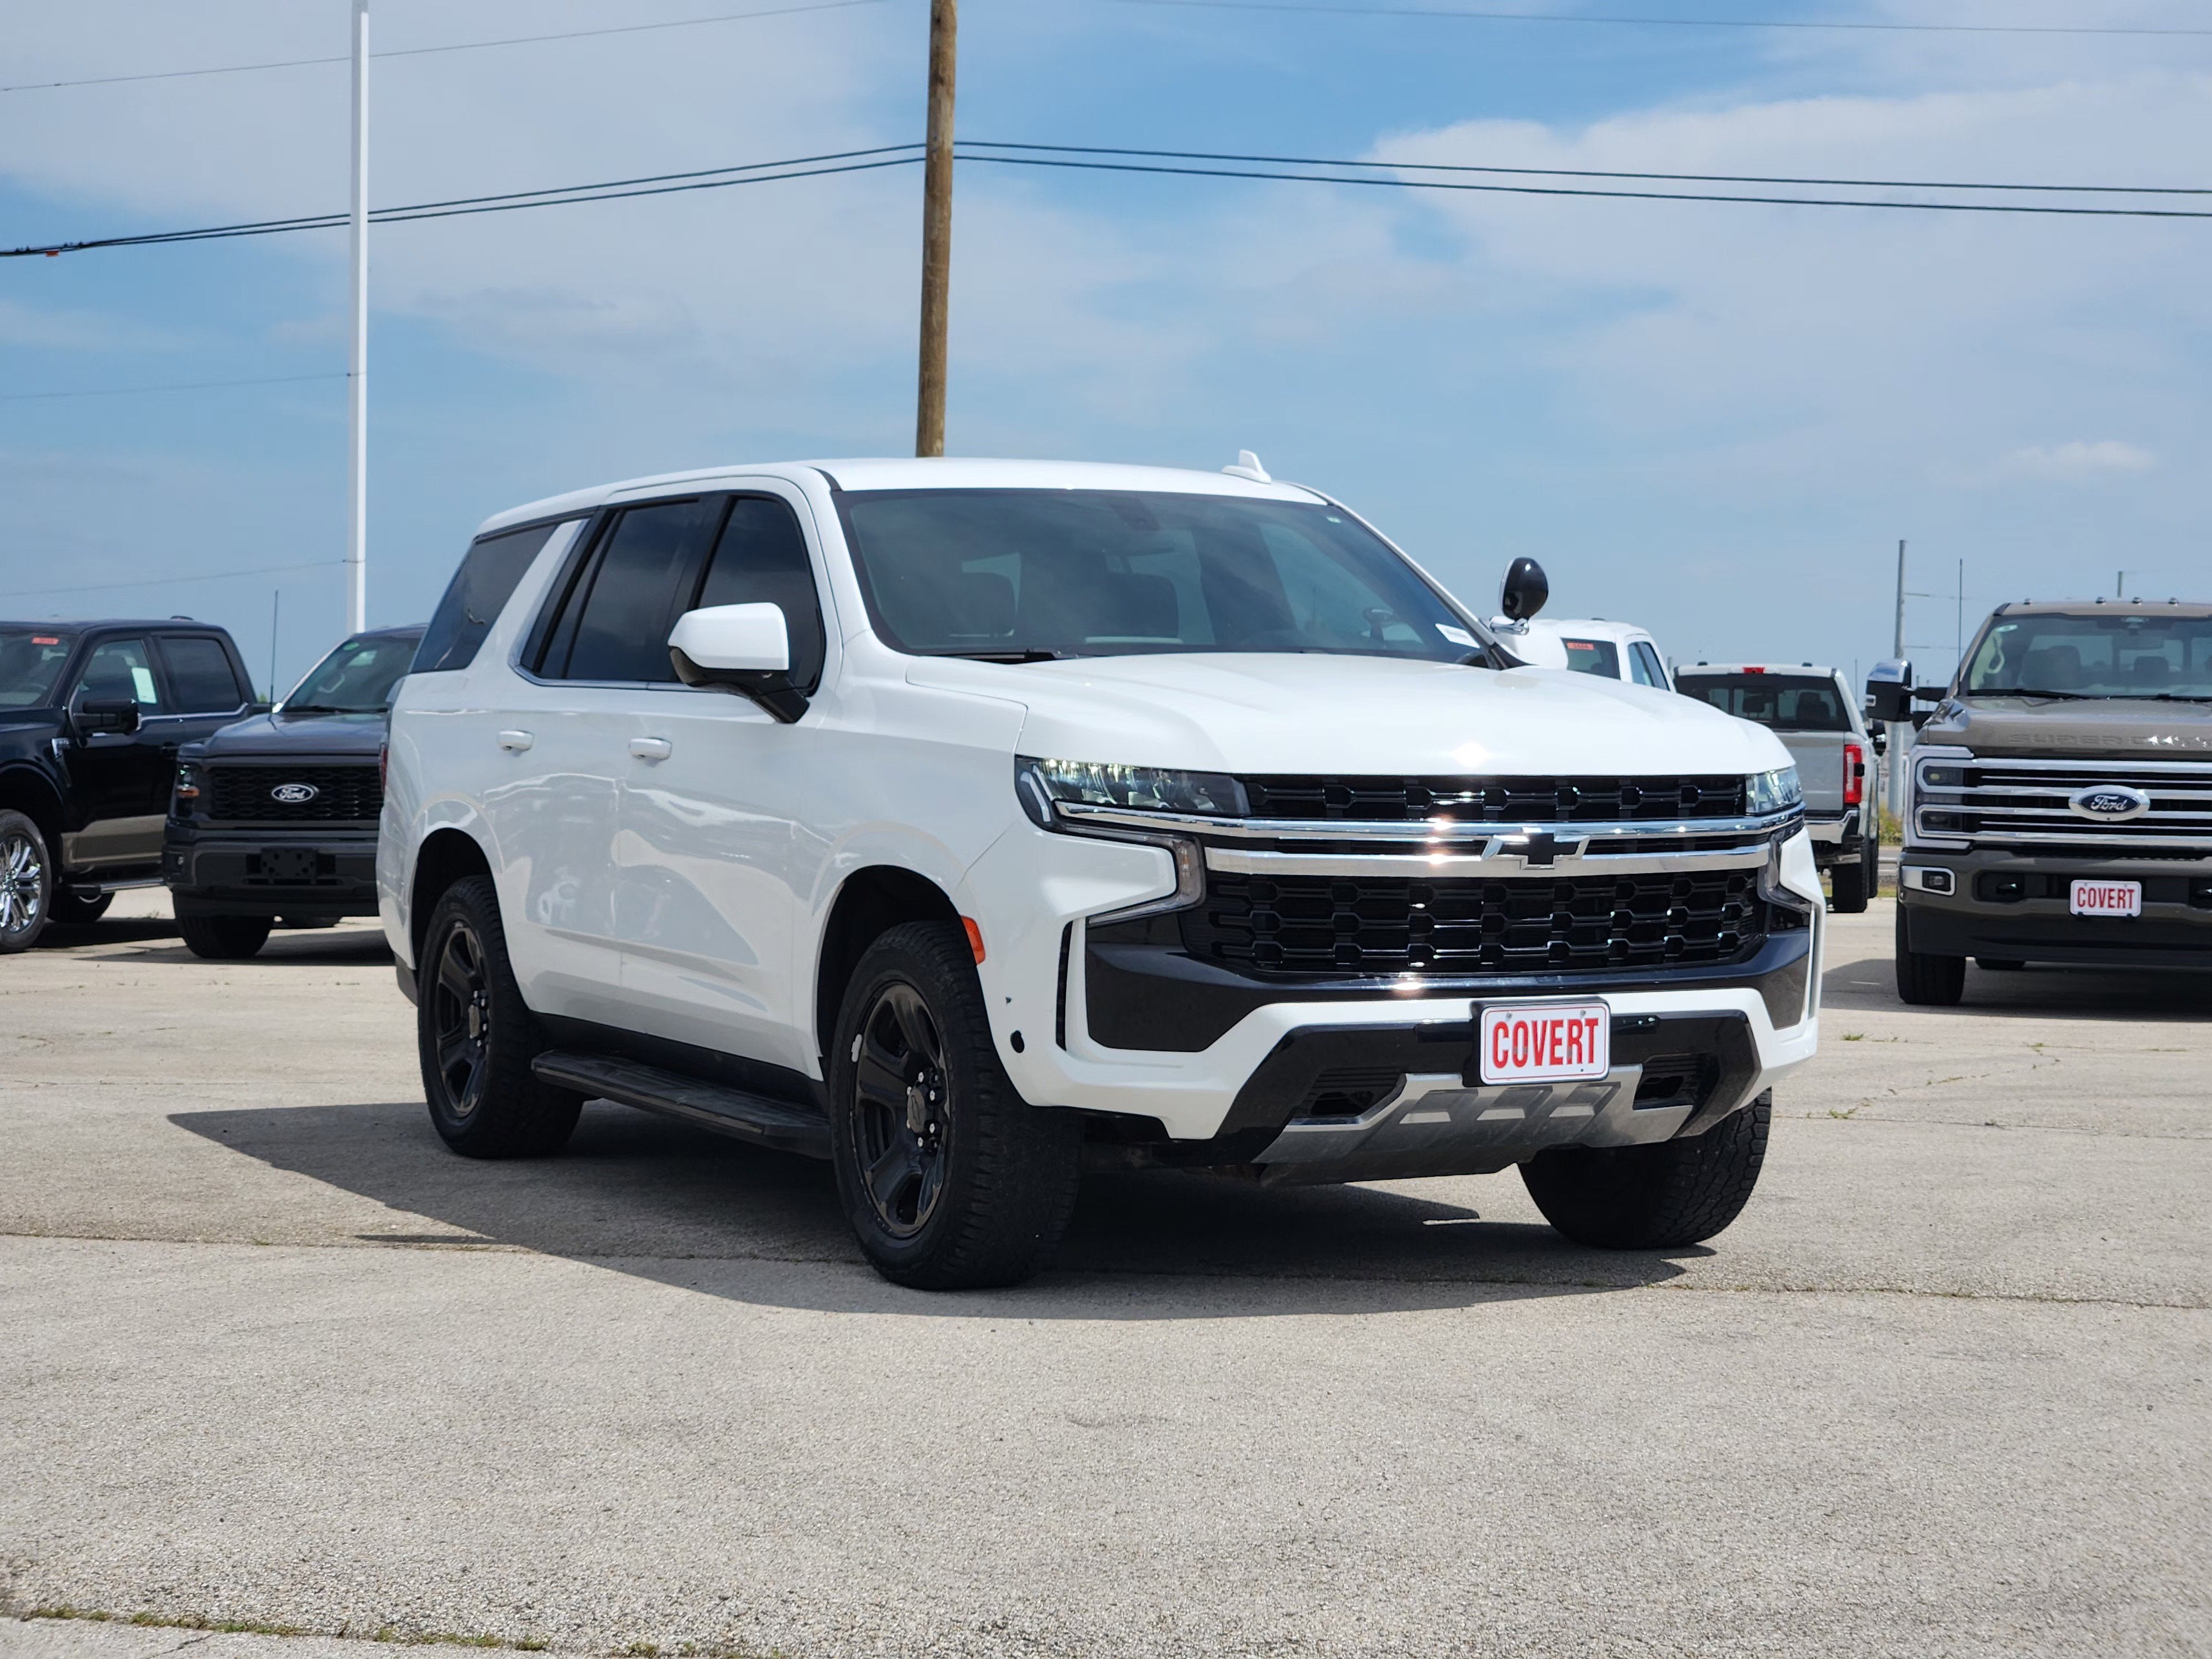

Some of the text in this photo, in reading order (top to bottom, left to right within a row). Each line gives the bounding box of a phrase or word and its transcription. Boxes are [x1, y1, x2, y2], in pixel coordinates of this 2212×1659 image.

[279, 786, 306, 799] Ford
[2090, 795, 2128, 811] Ford
[2077, 886, 2135, 909] COVERT
[1493, 1018, 1599, 1069] COVERT
